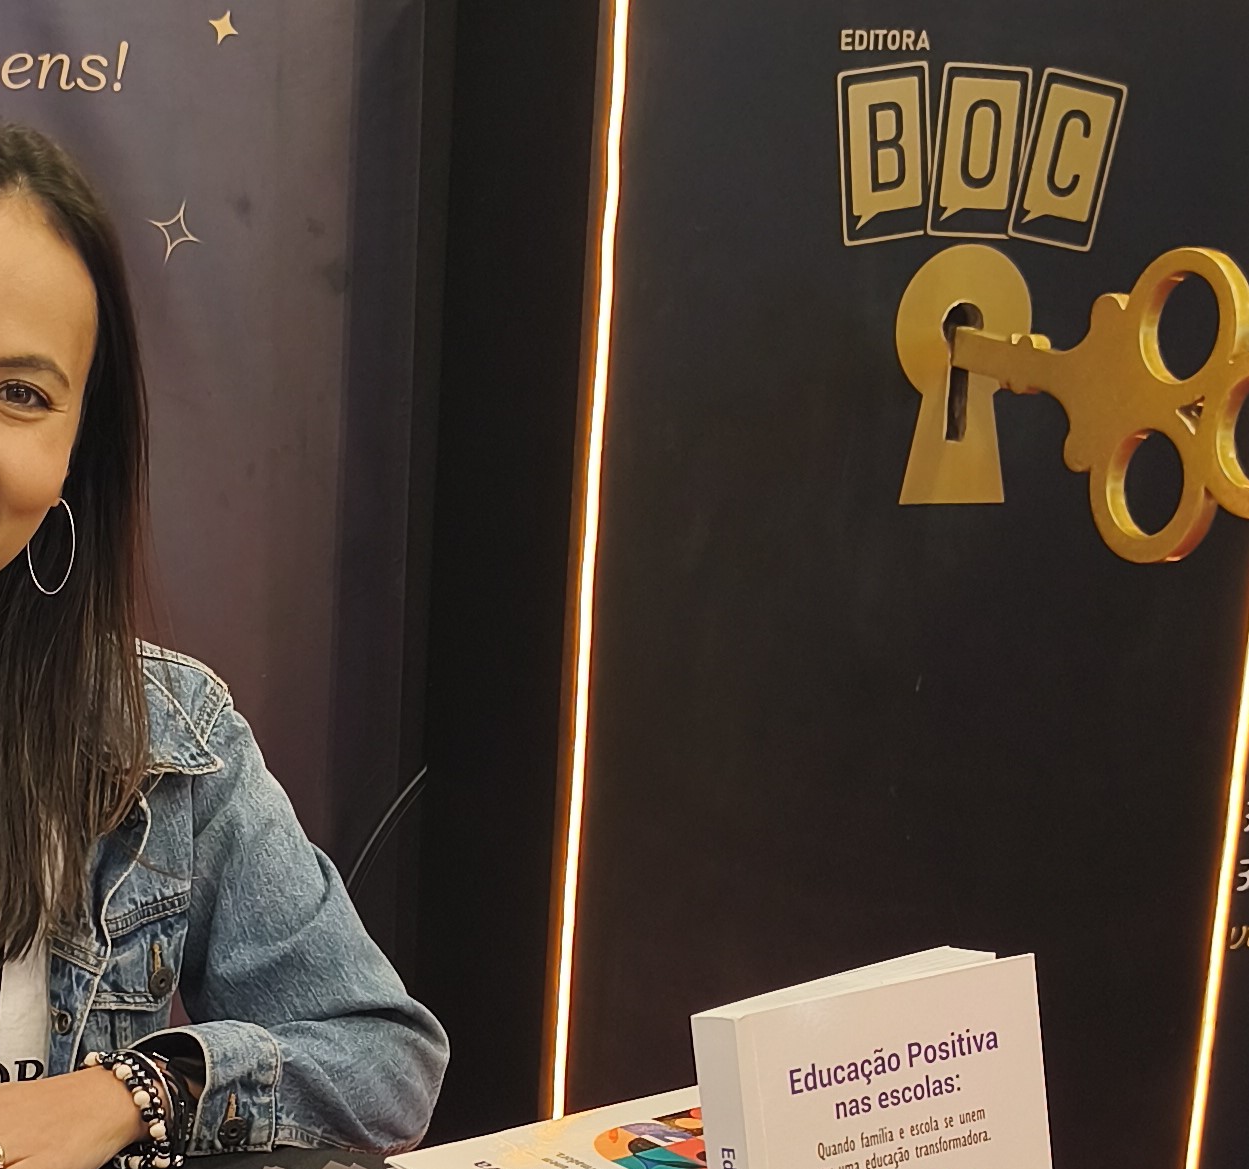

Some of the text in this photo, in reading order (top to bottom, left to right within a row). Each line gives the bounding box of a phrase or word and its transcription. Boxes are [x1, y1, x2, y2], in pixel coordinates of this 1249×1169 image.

[839, 28, 930, 51] EDITORA
[850, 80, 1112, 216] BOC
[788, 1028, 999, 1095] Educação Positiva
[834, 1073, 961, 1120] nas escolas:
[817, 1107, 986, 1161] Quando família e escola se unem
[864, 1146, 910, 1169] educação
[915, 1128, 992, 1160] transformadora.
